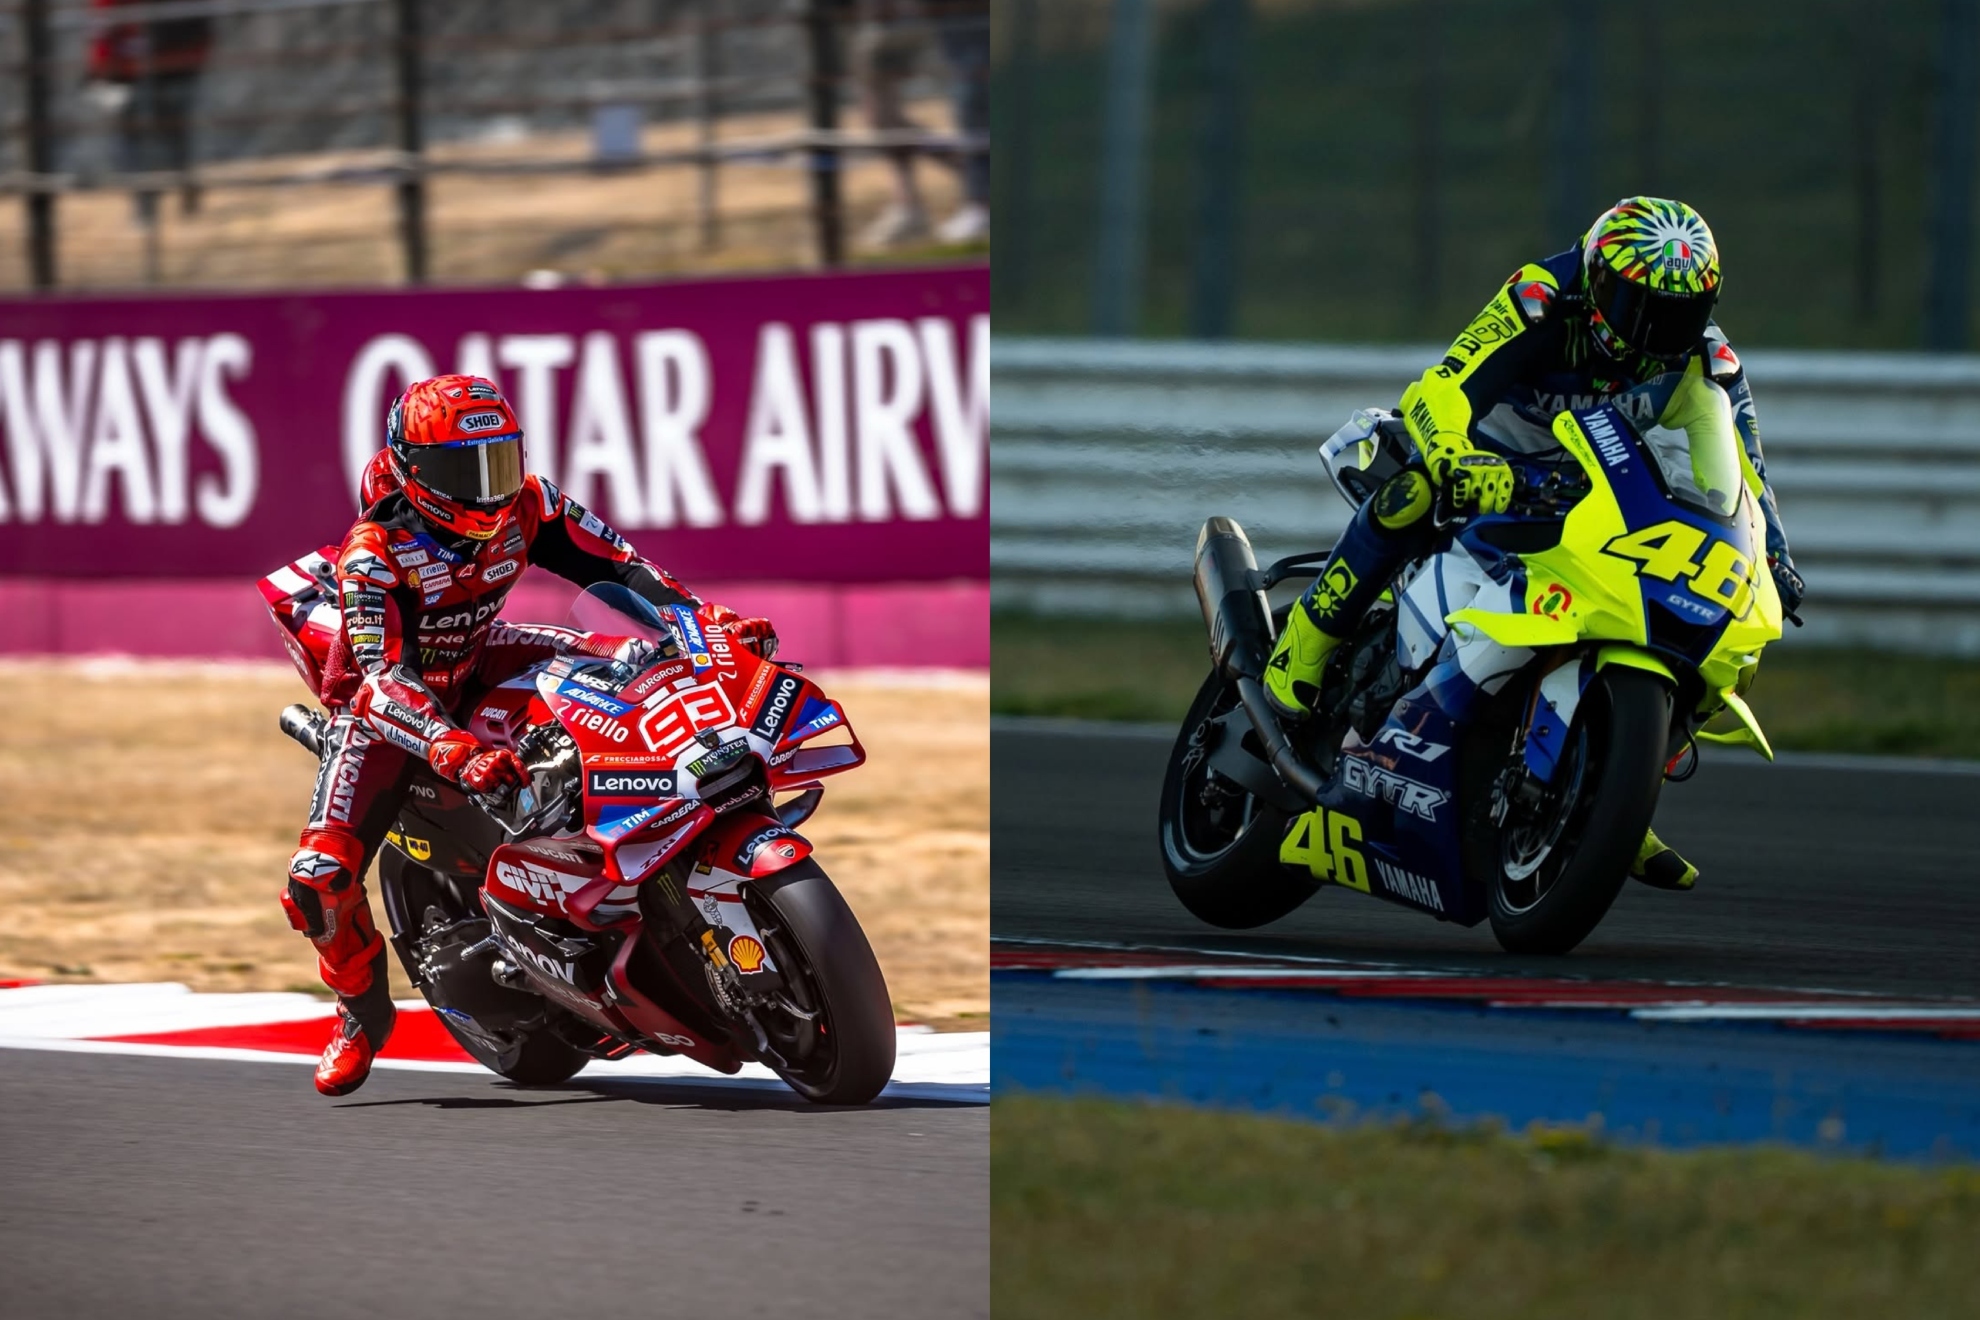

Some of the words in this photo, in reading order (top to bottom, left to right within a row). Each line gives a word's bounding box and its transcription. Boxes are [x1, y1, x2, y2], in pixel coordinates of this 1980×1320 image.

[1666, 258, 1690, 271] agv
[0, 332, 260, 528] WAYS
[466, 414, 500, 430] SHOEI
[1582, 409, 1631, 467] YAMAHA
[417, 496, 452, 520] Lenovo
[476, 493, 505, 503] Insta360
[437, 548, 455, 561] TIM
[503, 535, 521, 547] Lenovo
[426, 564, 447, 575] riello
[487, 562, 514, 580] SHOEI
[1599, 520, 1757, 622] 46
[346, 612, 384, 628] aruba.it
[1667, 594, 1716, 620] GYTR
[675, 607, 704, 649] ADVANCE
[705, 624, 735, 666] riello
[571, 671, 613, 692] WRS
[634, 664, 684, 694] VARGROUP
[480, 706, 508, 721] DUCATI
[563, 687, 624, 715] ADVANCE
[755, 678, 796, 739] Lenovo
[388, 703, 424, 730] Lenovo
[570, 706, 629, 743] riello
[641, 683, 734, 756] 93
[808, 712, 838, 730] TIM
[388, 726, 423, 753] Unipol
[702, 739, 747, 766] MONSTER
[1379, 728, 1451, 762] R1
[604, 755, 667, 765] FRECCIAROSSA
[330, 731, 371, 824] DUCATI
[593, 774, 672, 791] Lenovo
[1343, 754, 1448, 822] GYTR
[714, 785, 760, 813] aruba.it
[621, 808, 651, 830] TIM
[650, 799, 700, 829] CARRERA
[526, 844, 584, 864] DUCATI
[640, 838, 676, 869] ZYN
[1280, 805, 1371, 894] 46
[496, 860, 556, 900] GIVI
[1374, 858, 1444, 911] YAMAHA
